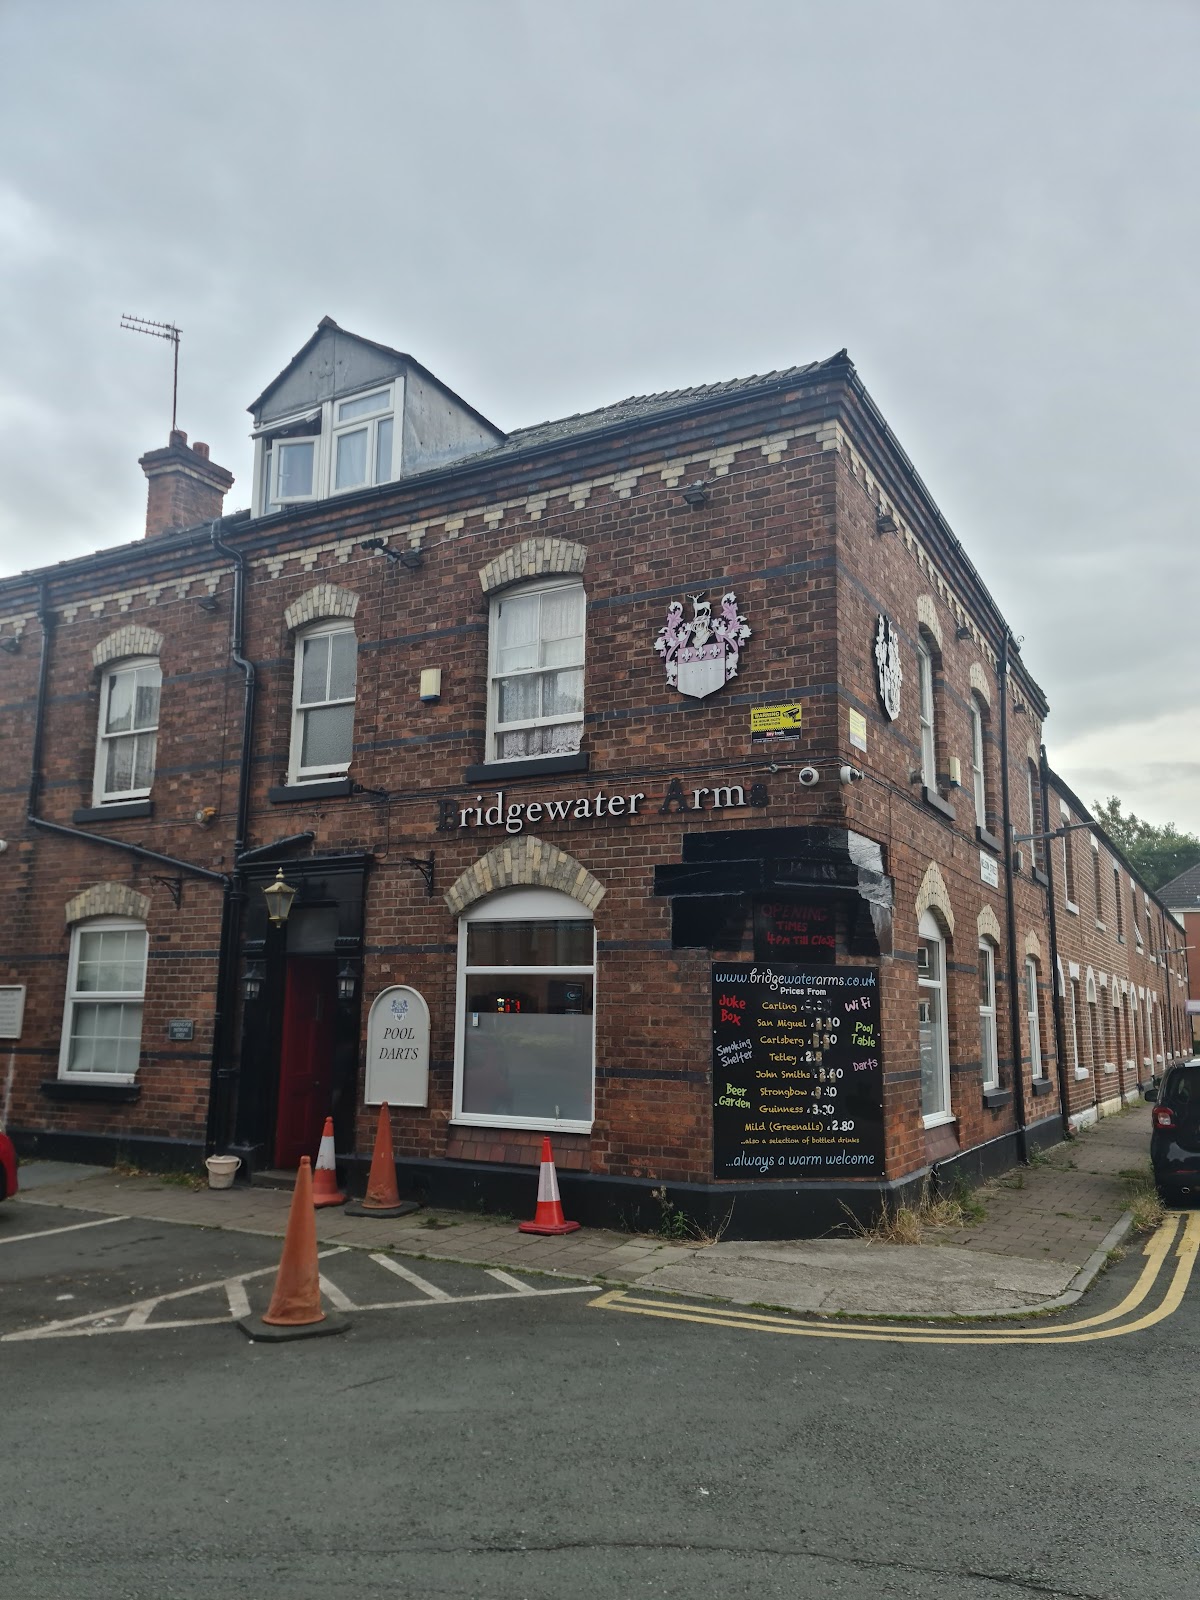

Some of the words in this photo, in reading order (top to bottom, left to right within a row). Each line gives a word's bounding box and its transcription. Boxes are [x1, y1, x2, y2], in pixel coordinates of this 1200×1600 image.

[754, 711, 780, 719] WARNING
[761, 903, 829, 921] OPENING
[715, 968, 876, 990] www.bridgewaterarms.co.uk
[780, 986, 805, 995] Prices
[807, 987, 827, 996] From
[719, 994, 746, 1009] Juke
[762, 1001, 797, 1013] Carling
[721, 1009, 741, 1026] Box
[757, 1018, 774, 1027] San
[777, 1019, 807, 1030] Miguel
[383, 1027, 415, 1040] POOL
[855, 1021, 874, 1034] Pool
[760, 1034, 805, 1047] Carlsberg
[851, 1033, 876, 1048] Table
[378, 1047, 419, 1060] DARTS
[716, 1039, 753, 1056] Smoking
[721, 1050, 753, 1067] Shelter
[769, 1052, 797, 1065] Tetley
[852, 1058, 878, 1072] Darts
[755, 1069, 778, 1079] John
[781, 1069, 811, 1079] Smiths
[726, 1082, 747, 1097] Beer
[760, 1086, 808, 1099] Strongbow
[719, 1095, 750, 1109] Garden
[759, 1104, 803, 1113] Guinness
[744, 1122, 766, 1132] Mild
[769, 1121, 824, 1133] (Greenalls)
[801, 1136, 810, 1145] of
[812, 1136, 836, 1144] bottled
[838, 1136, 860, 1144] drinks
[725, 1150, 775, 1173] ...always
[778, 1155, 785, 1166] a
[788, 1154, 822, 1166] warm
[825, 1149, 875, 1165] welcome
